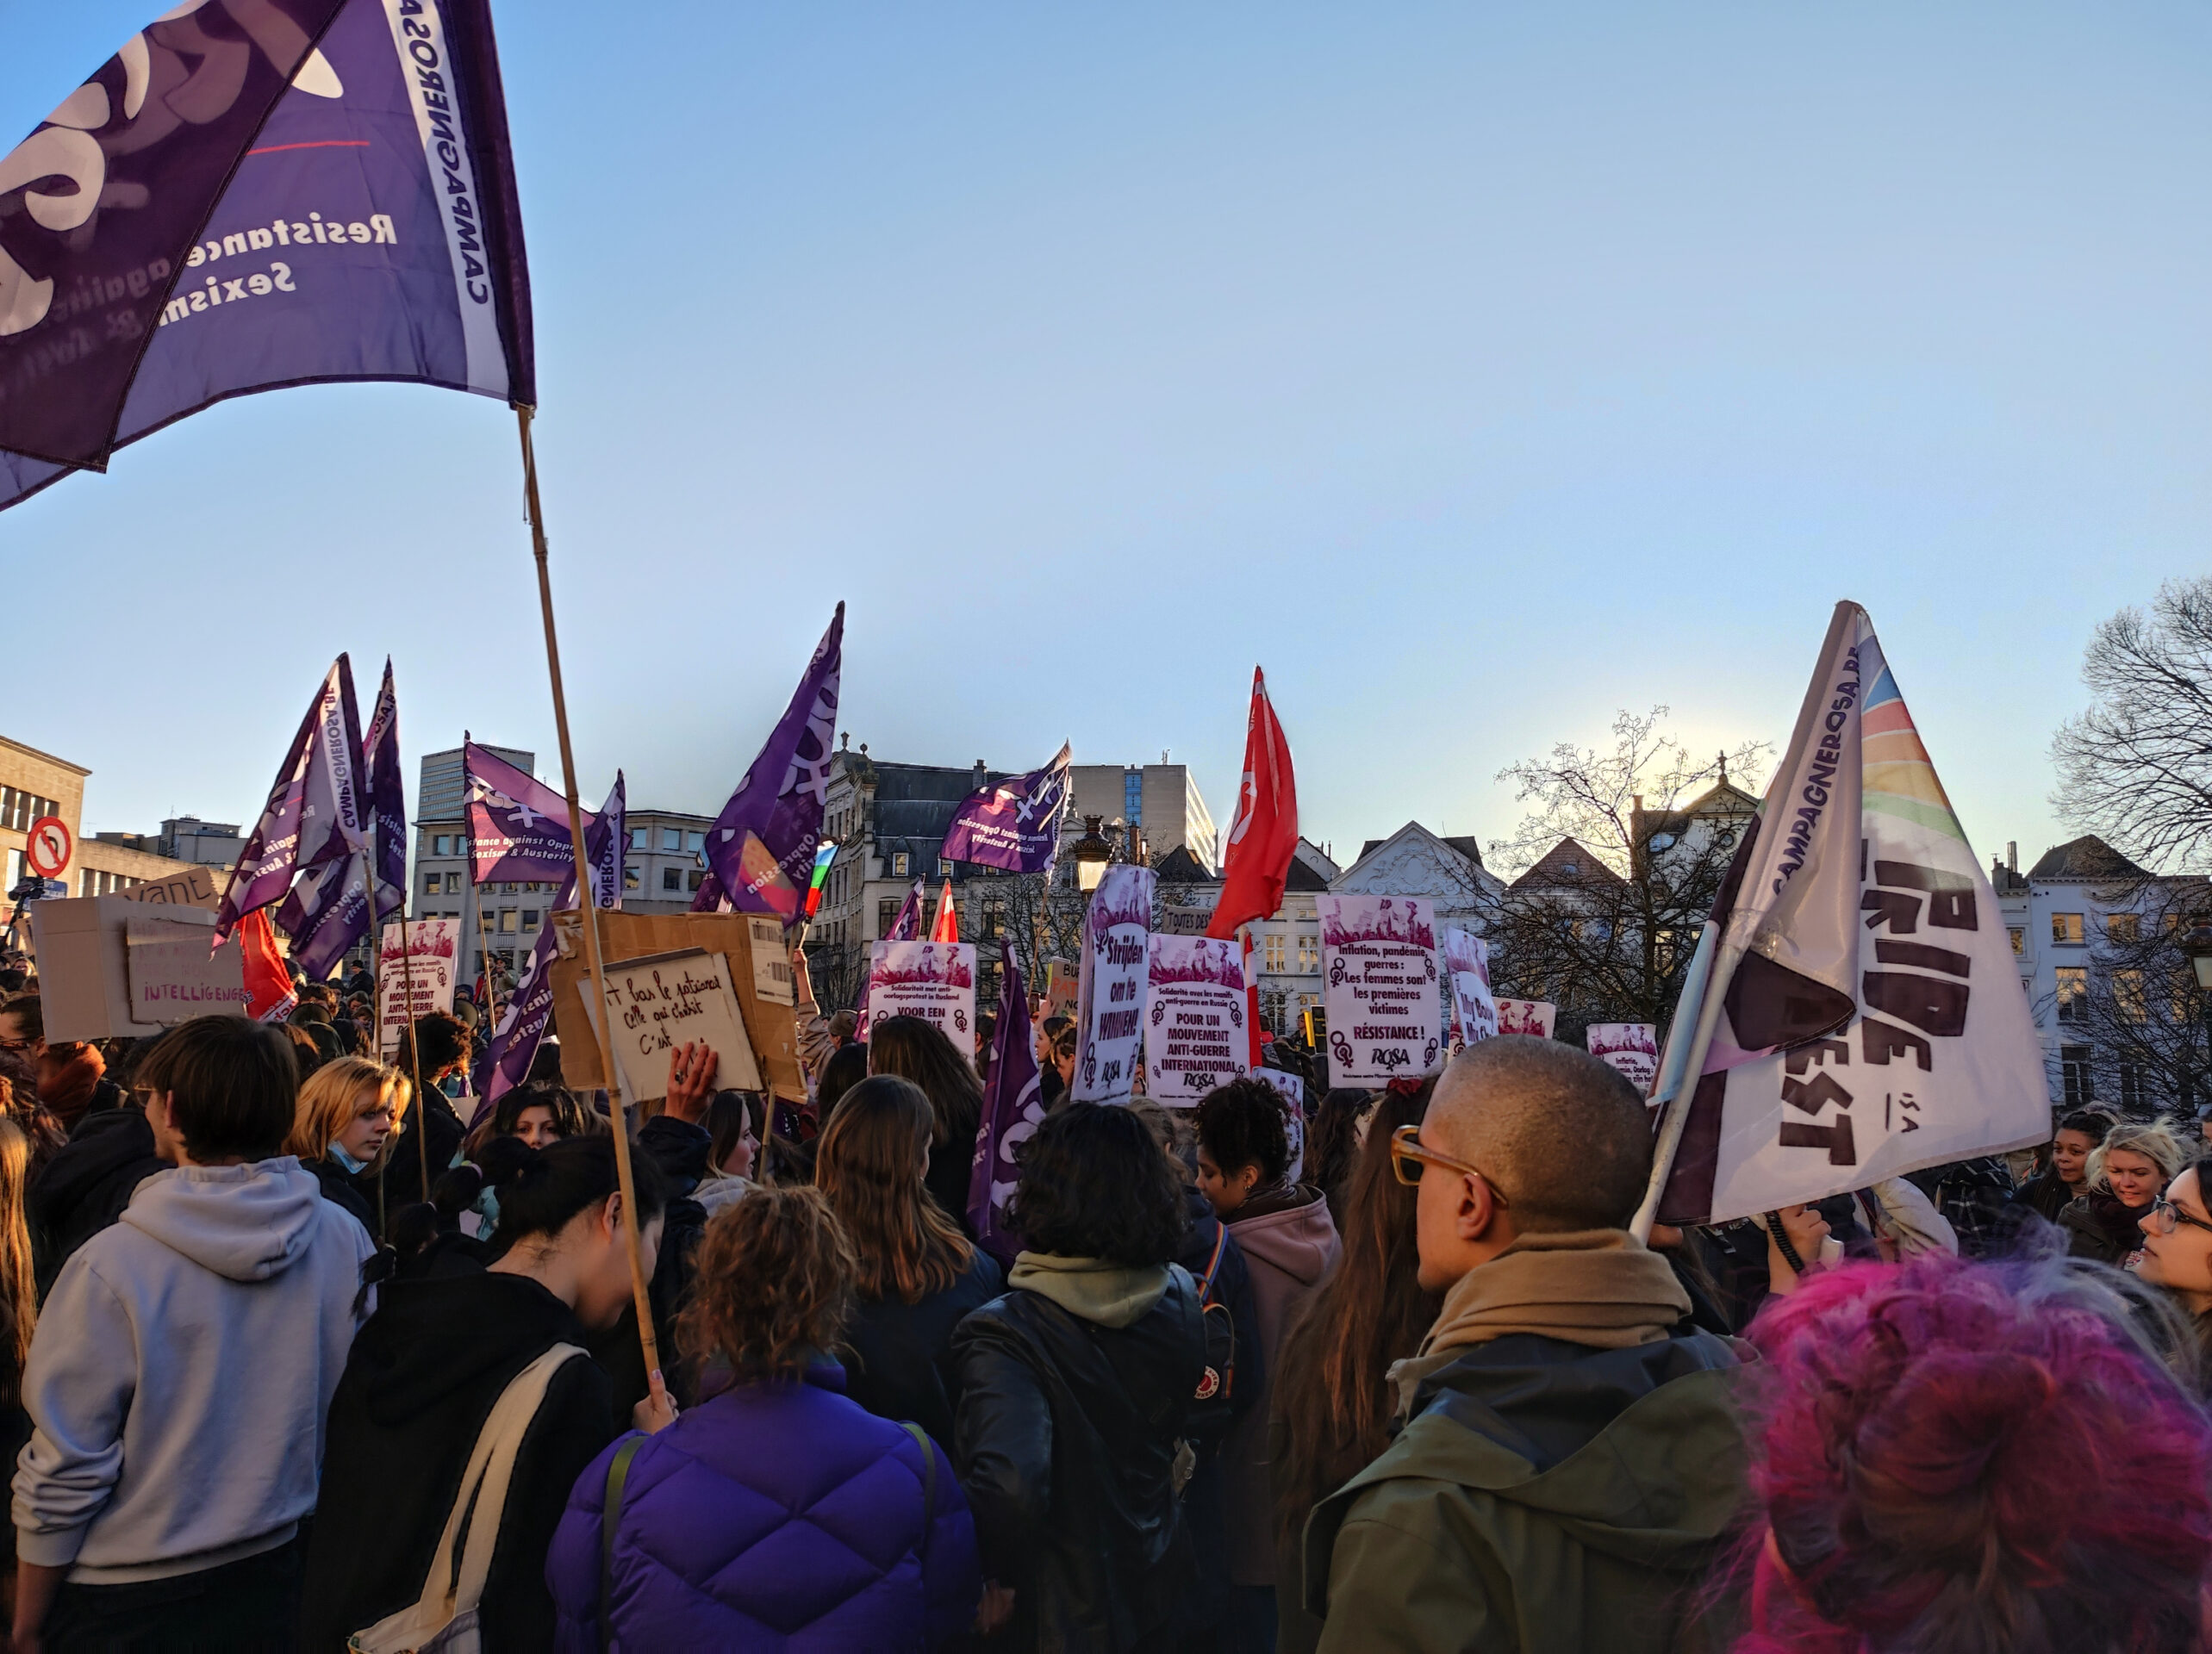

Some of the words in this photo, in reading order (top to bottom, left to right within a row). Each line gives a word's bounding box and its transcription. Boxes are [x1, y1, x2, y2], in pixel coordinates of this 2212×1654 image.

[503, 835, 544, 847] against
[510, 849, 519, 857] &
[521, 848, 576, 862] Austerity
[1106, 936, 1143, 972] Strijden
[1338, 944, 1380, 957] Inflation,
[1364, 961, 1399, 971] guerres
[1860, 860, 1978, 1073] PRIDE
[418, 979, 428, 988] UN
[626, 978, 656, 1002] bas
[653, 970, 672, 1000] le
[1344, 972, 1361, 984] Les
[1363, 972, 1404, 985] femmes
[1406, 975, 1426, 986] sont
[1354, 986, 1368, 999] les
[1372, 988, 1420, 1002] premières
[897, 1007, 925, 1017] VOOR
[928, 1008, 945, 1017] EEN
[1368, 1003, 1409, 1015] victimes
[653, 1006, 670, 1033] qui
[1176, 1013, 1204, 1025] POUR
[1206, 1015, 1220, 1026] UN
[1168, 1029, 1230, 1042] MOUVEMENT
[1354, 1023, 1418, 1040] RÉSISTANCE
[1421, 1026, 1424, 1040] !
[1167, 1043, 1231, 1057] ANTI-GUERRE
[1372, 1048, 1411, 1065] ROSA
[1161, 1059, 1237, 1073] INTERNATIONAL
[1183, 1073, 1218, 1087] ROSA
